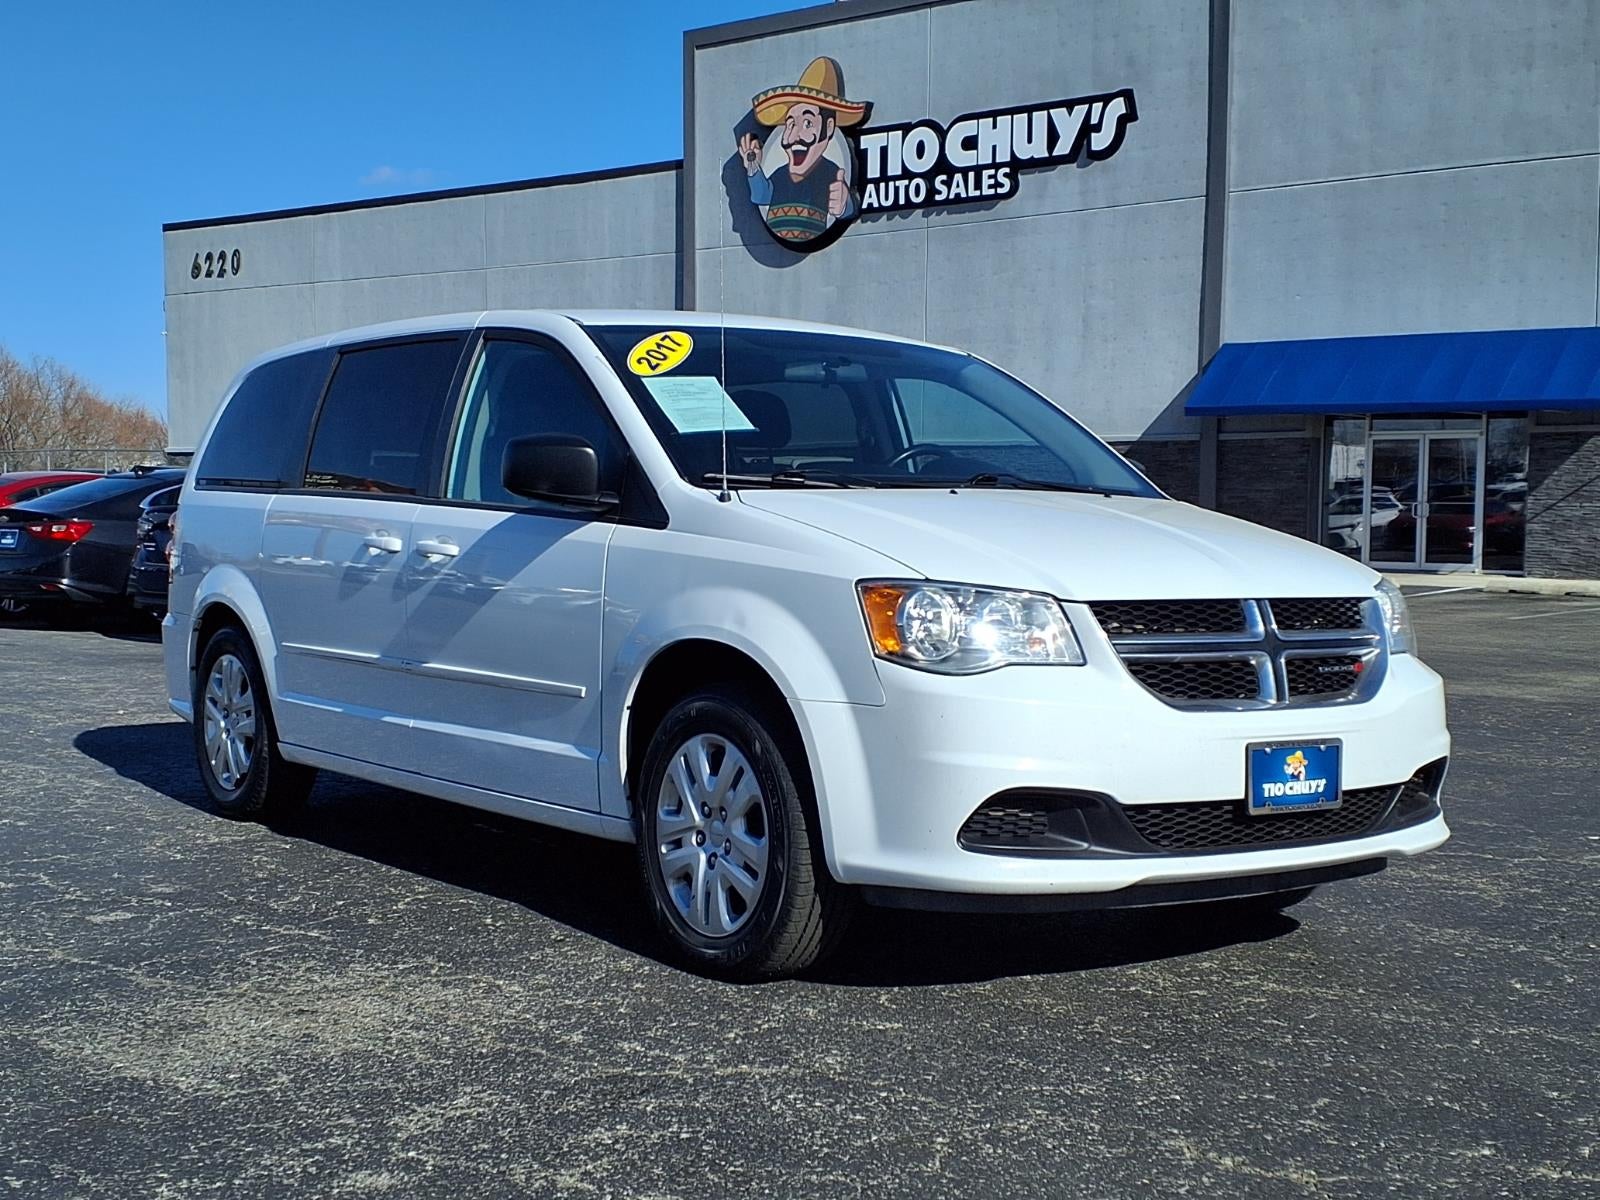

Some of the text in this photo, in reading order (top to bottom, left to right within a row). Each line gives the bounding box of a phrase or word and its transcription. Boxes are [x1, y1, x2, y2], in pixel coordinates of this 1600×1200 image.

[860, 96, 1127, 178] TIO CHUY'S
[862, 167, 1011, 209] AUTO SALES
[191, 248, 241, 280] 6220
[636, 334, 683, 371] 2017
[1262, 778, 1327, 798] TIO CHUY'S
